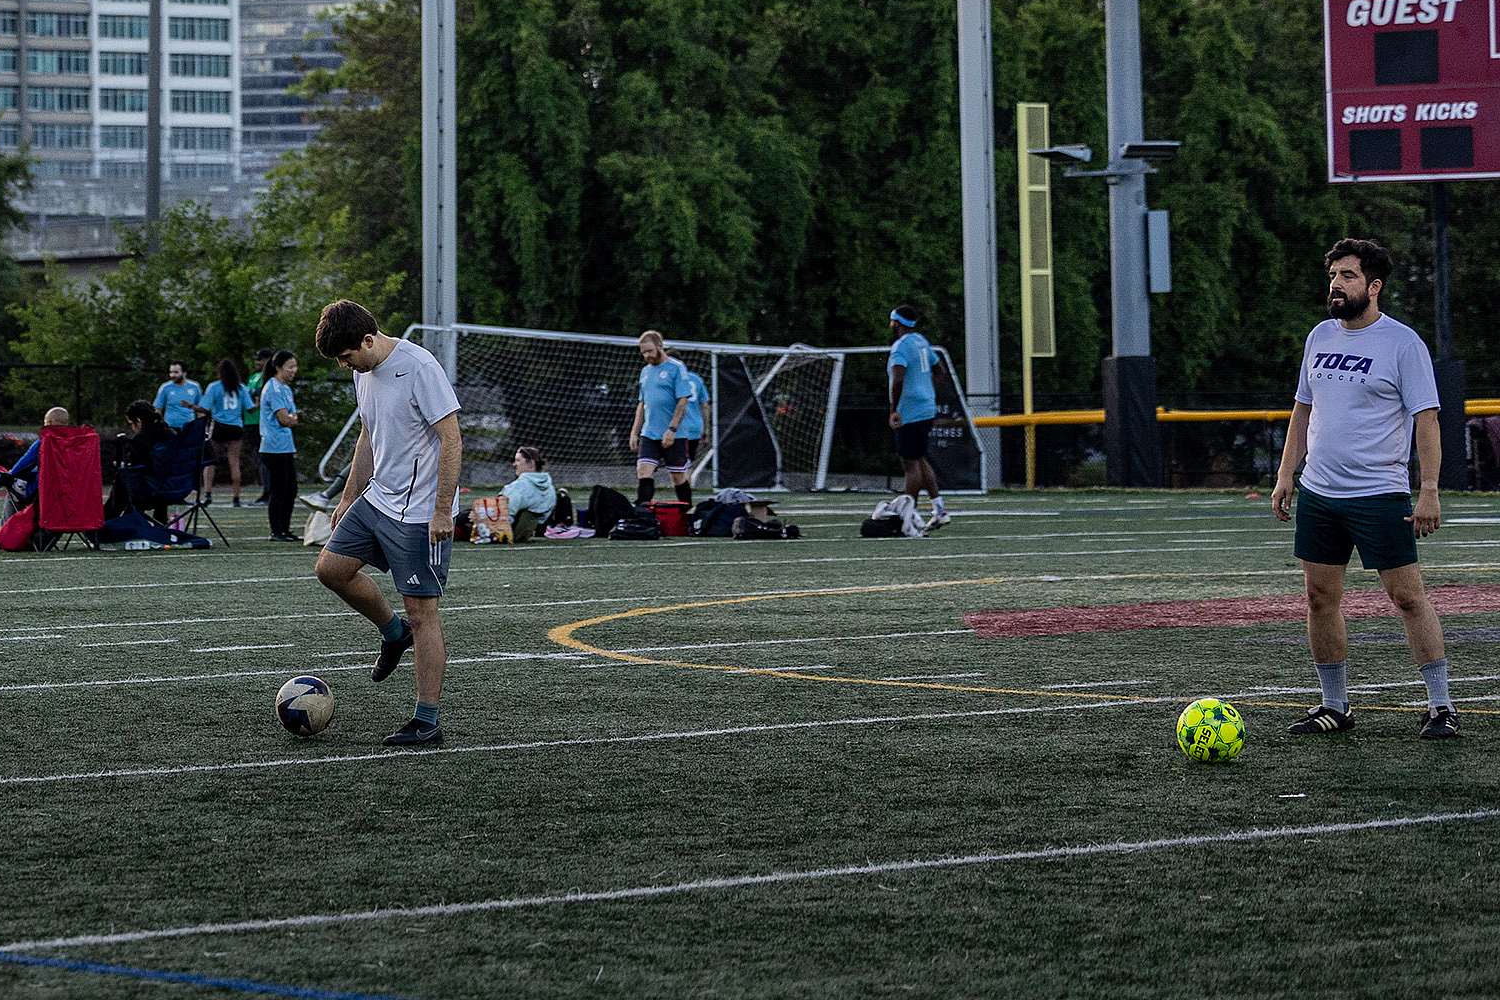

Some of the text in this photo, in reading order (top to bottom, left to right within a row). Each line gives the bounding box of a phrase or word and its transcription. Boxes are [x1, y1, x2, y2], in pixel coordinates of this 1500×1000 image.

[1342, 101, 1478, 124] SHOTS KICKS
[1312, 353, 1374, 374] TOCA
